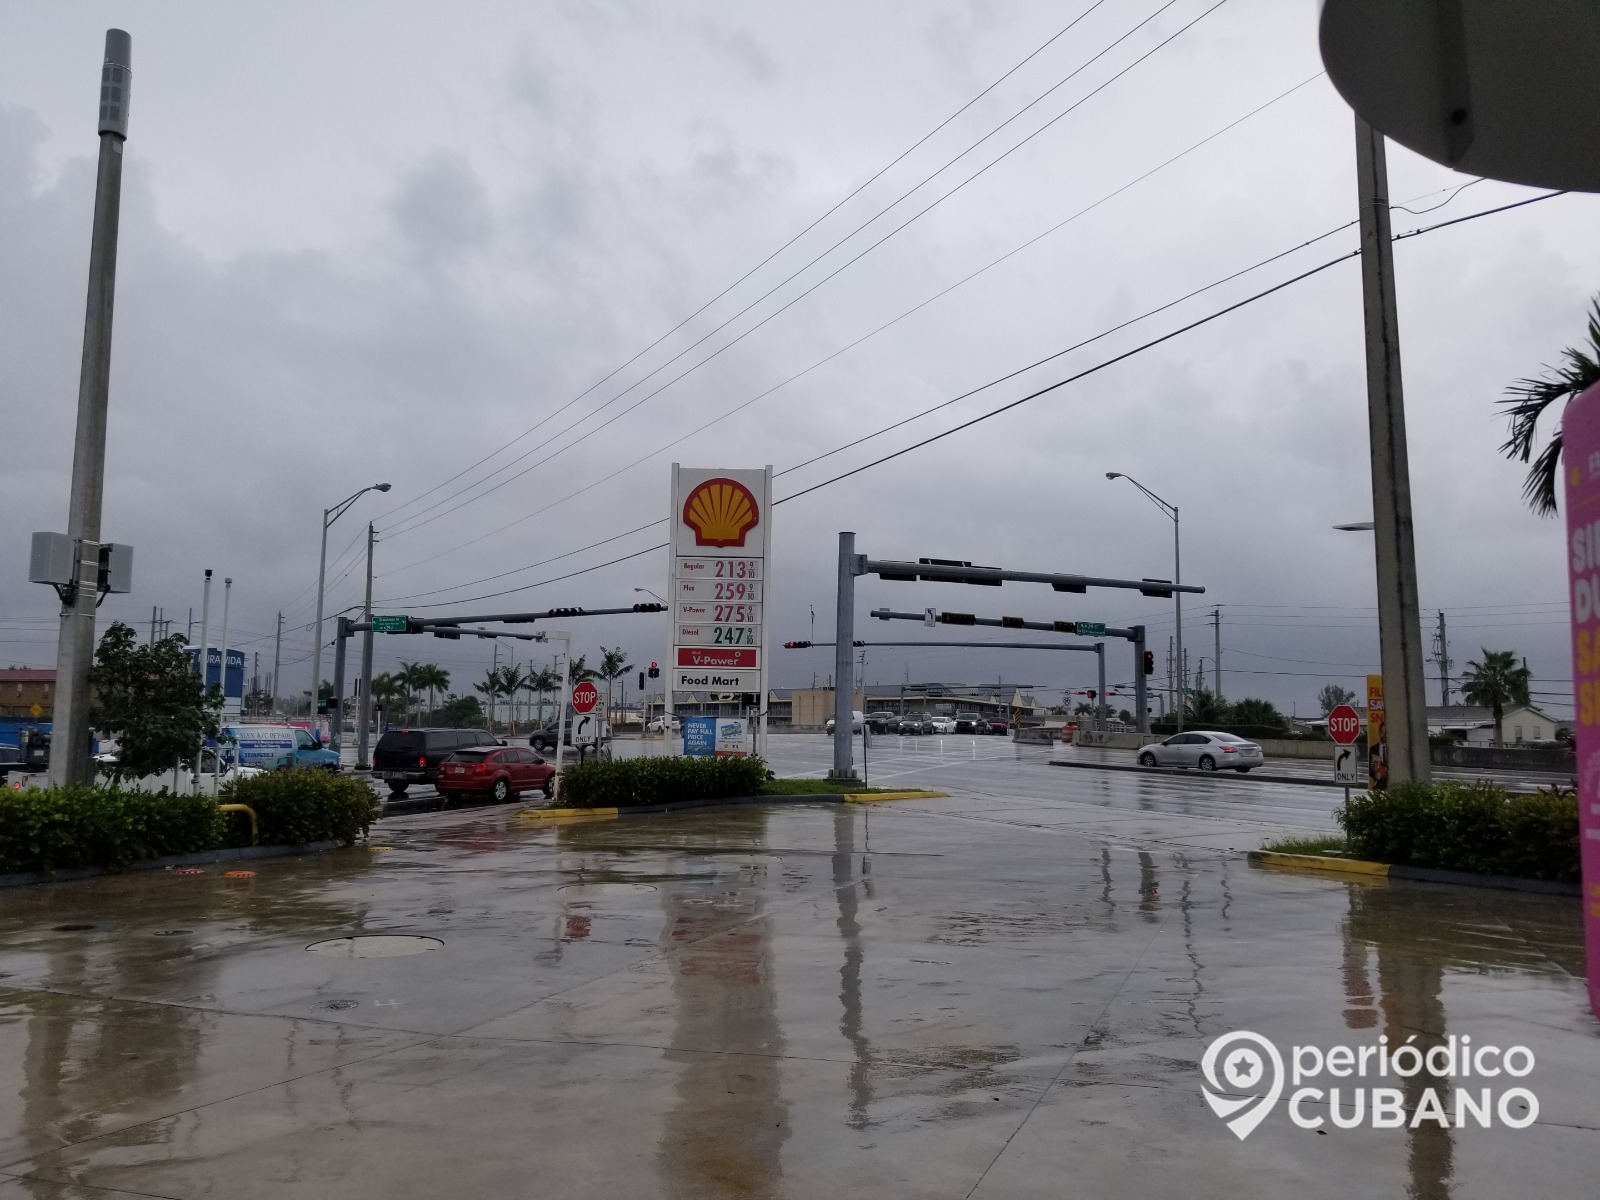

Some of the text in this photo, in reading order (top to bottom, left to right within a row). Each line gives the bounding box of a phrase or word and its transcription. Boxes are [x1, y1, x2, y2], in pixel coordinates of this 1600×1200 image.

[715, 560, 746, 579] 213
[714, 582, 746, 600] 259
[682, 606, 706, 614] V-Power
[714, 604, 745, 623] 275
[682, 628, 699, 636] Diesel
[713, 626, 744, 645] 247
[692, 655, 739, 666] V-Power
[681, 675, 740, 686] Food Mart
[574, 692, 596, 704] STOP
[1330, 717, 1358, 732] STOP
[1336, 772, 1355, 781] ONLY
